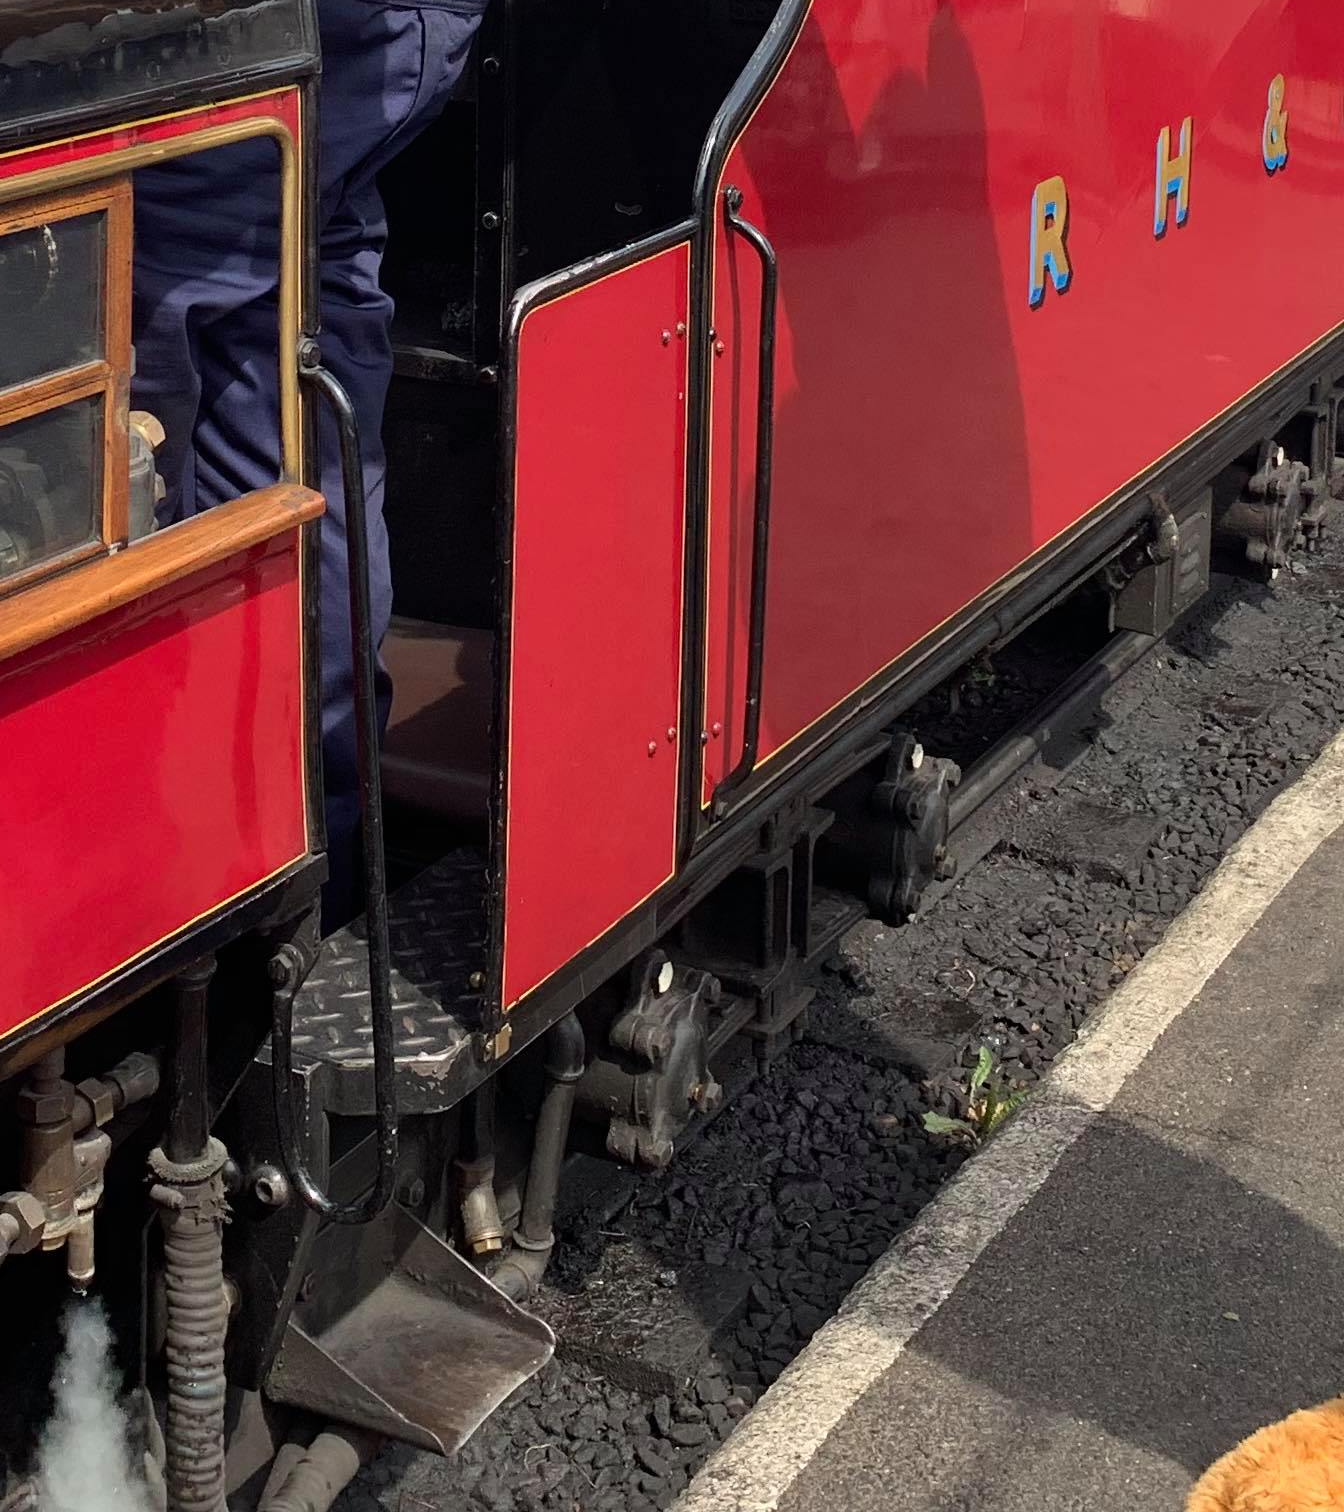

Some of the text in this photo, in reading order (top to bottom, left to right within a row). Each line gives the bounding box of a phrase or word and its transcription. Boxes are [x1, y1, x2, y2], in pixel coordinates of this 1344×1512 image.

[1028, 175, 1073, 312] R
[1153, 116, 1194, 241] H
[1262, 73, 1289, 176] &
